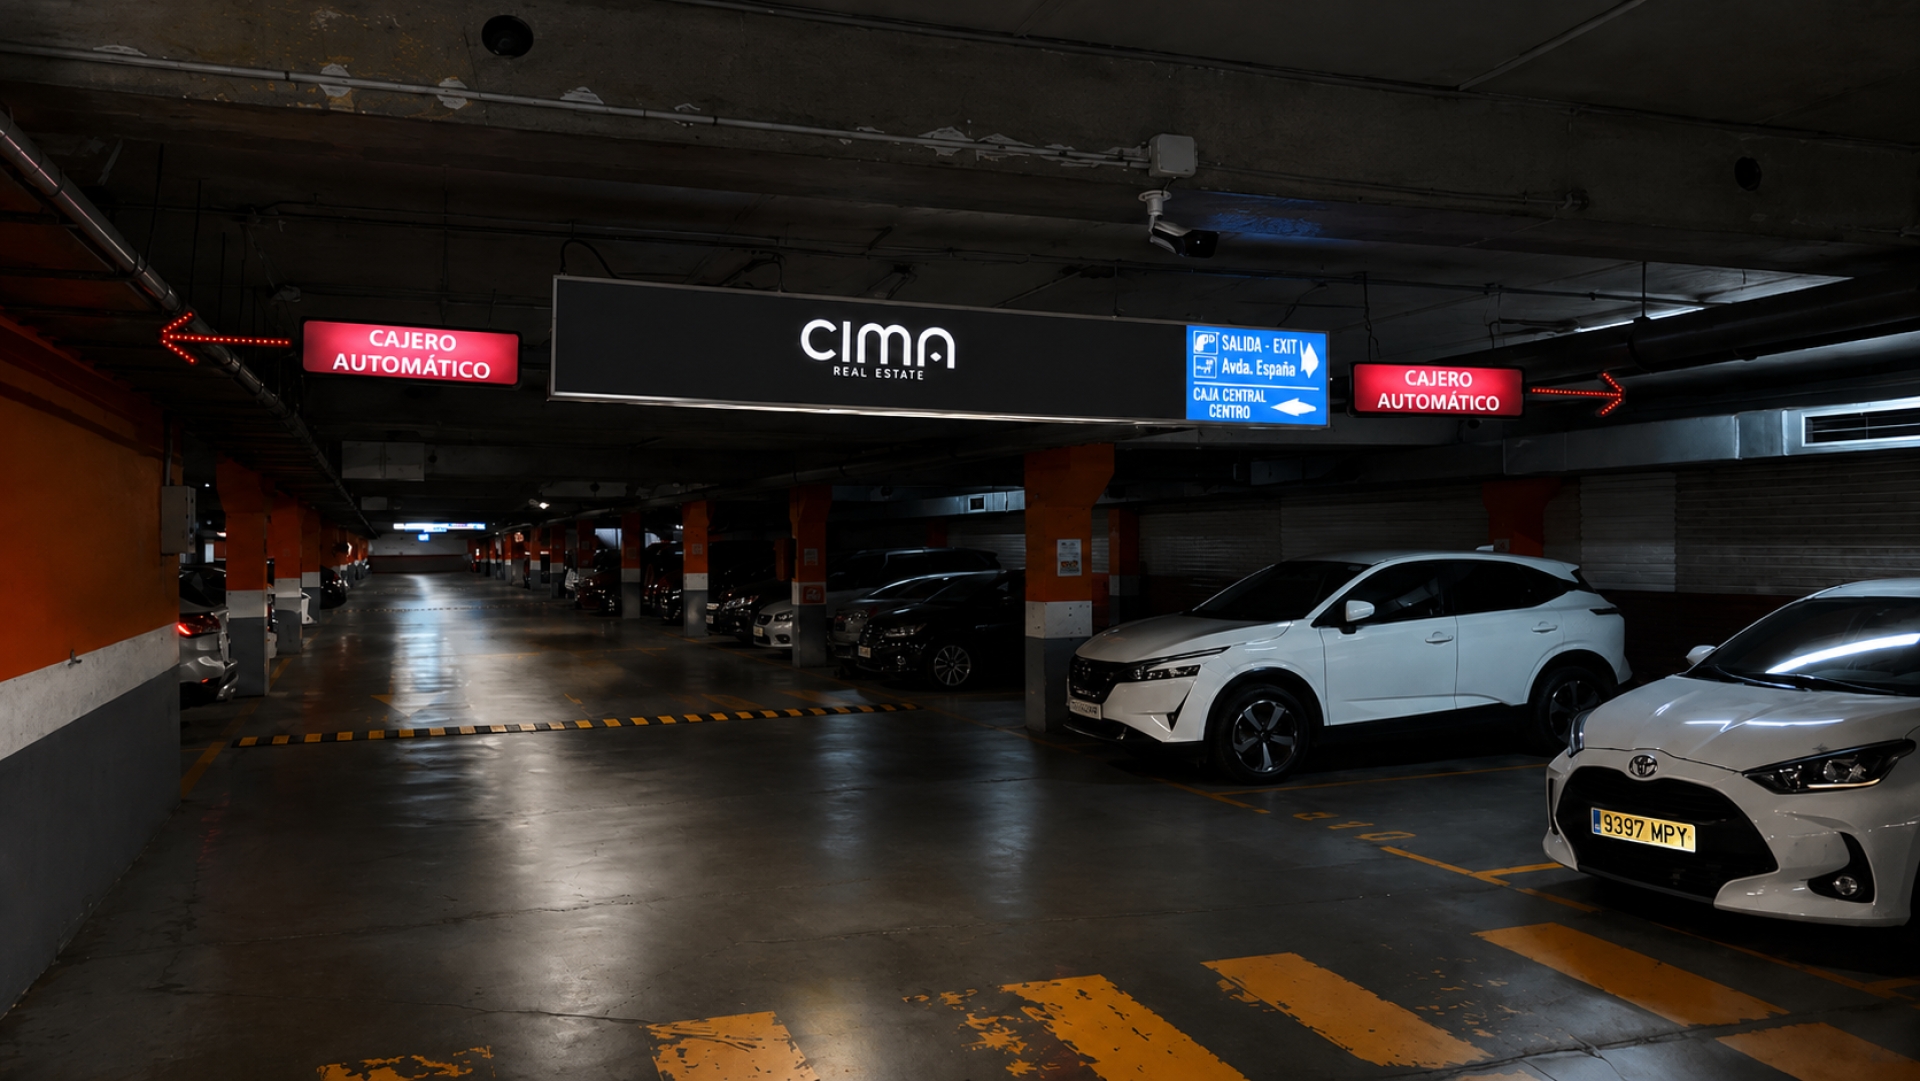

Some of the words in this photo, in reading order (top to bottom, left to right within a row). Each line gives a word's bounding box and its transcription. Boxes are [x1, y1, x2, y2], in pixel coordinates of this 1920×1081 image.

[369, 330, 457, 352] CAJERO
[801, 319, 955, 369] CIMA
[1222, 335, 1262, 353] SALIDA
[1273, 338, 1298, 354] EXIT
[332, 353, 491, 379] AUTOMÁTICO
[833, 366, 868, 378] REAL
[875, 368, 924, 380] ESTATE
[1222, 358, 1253, 375] Avda.
[1256, 359, 1296, 380] España
[1405, 370, 1473, 388] CAJERO
[1193, 387, 1220, 402] CAJA
[1222, 388, 1267, 403] CENTRAL
[1377, 391, 1500, 411] AUTOMÁTICO
[1209, 404, 1251, 419] CENTRO
[1603, 814, 1645, 839] 9397
[1651, 822, 1688, 848] MPY
